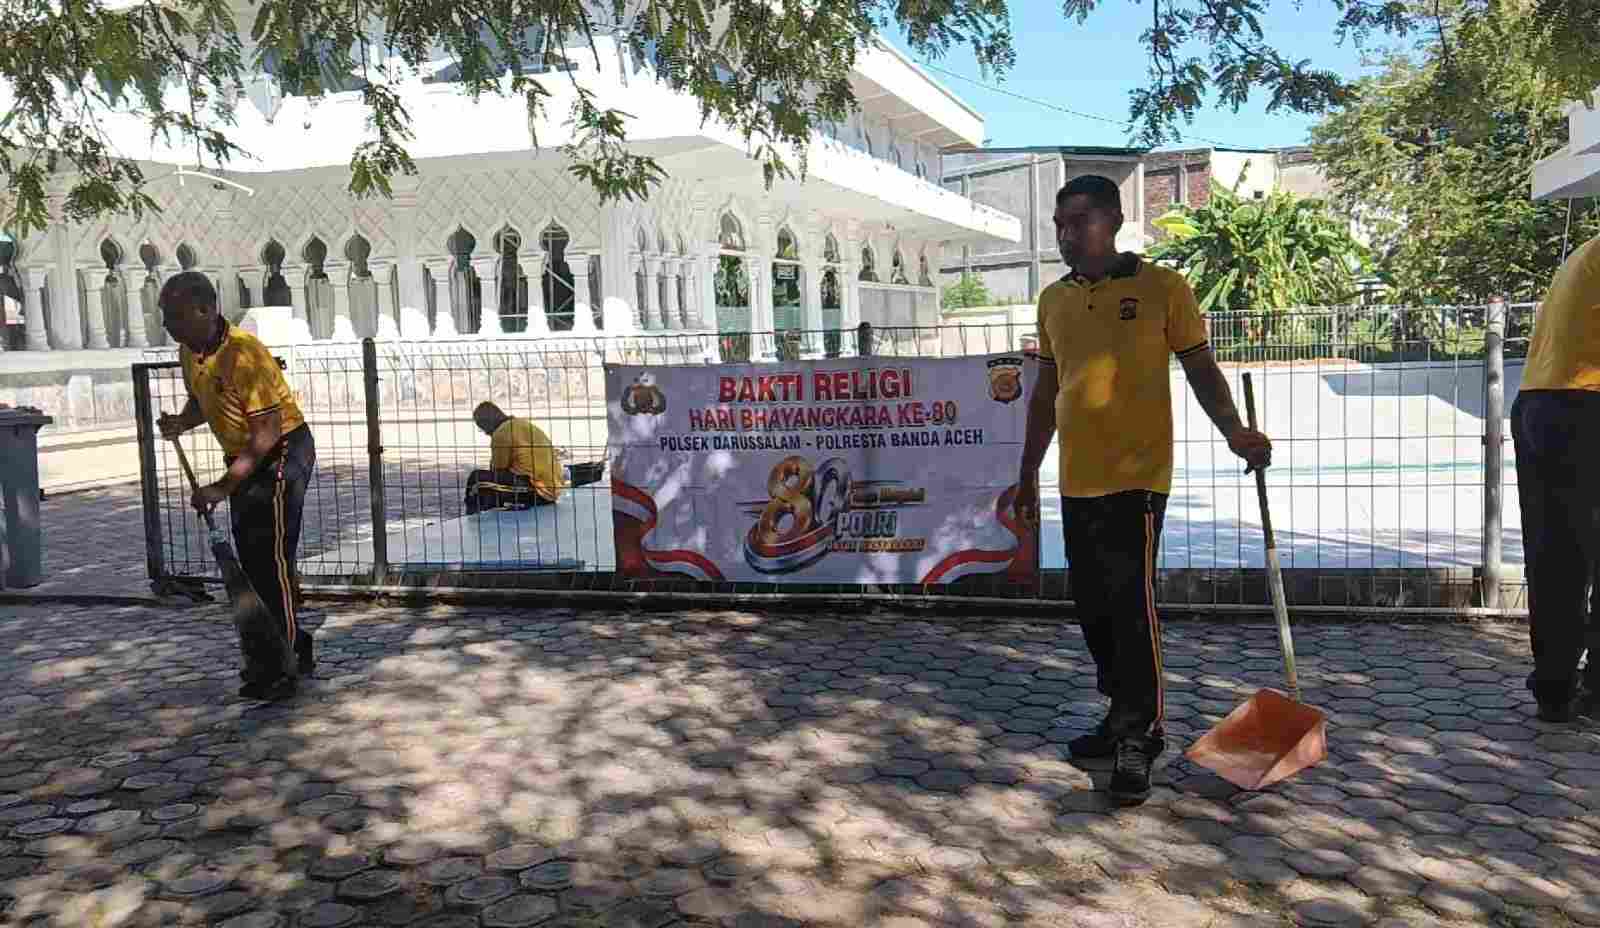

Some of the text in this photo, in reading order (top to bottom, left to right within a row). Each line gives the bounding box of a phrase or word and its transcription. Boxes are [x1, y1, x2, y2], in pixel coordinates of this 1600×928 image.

[719, 368, 912, 402] BAKTI RELIGI
[688, 400, 957, 431] HARI BHAYANGKARA KE-80
[660, 435, 709, 451] POLSEK
[713, 434, 801, 450] DARUSSALAM
[815, 432, 886, 450] POLRESTA
[891, 430, 939, 448] BANDA
[944, 428, 983, 446] ACEH
